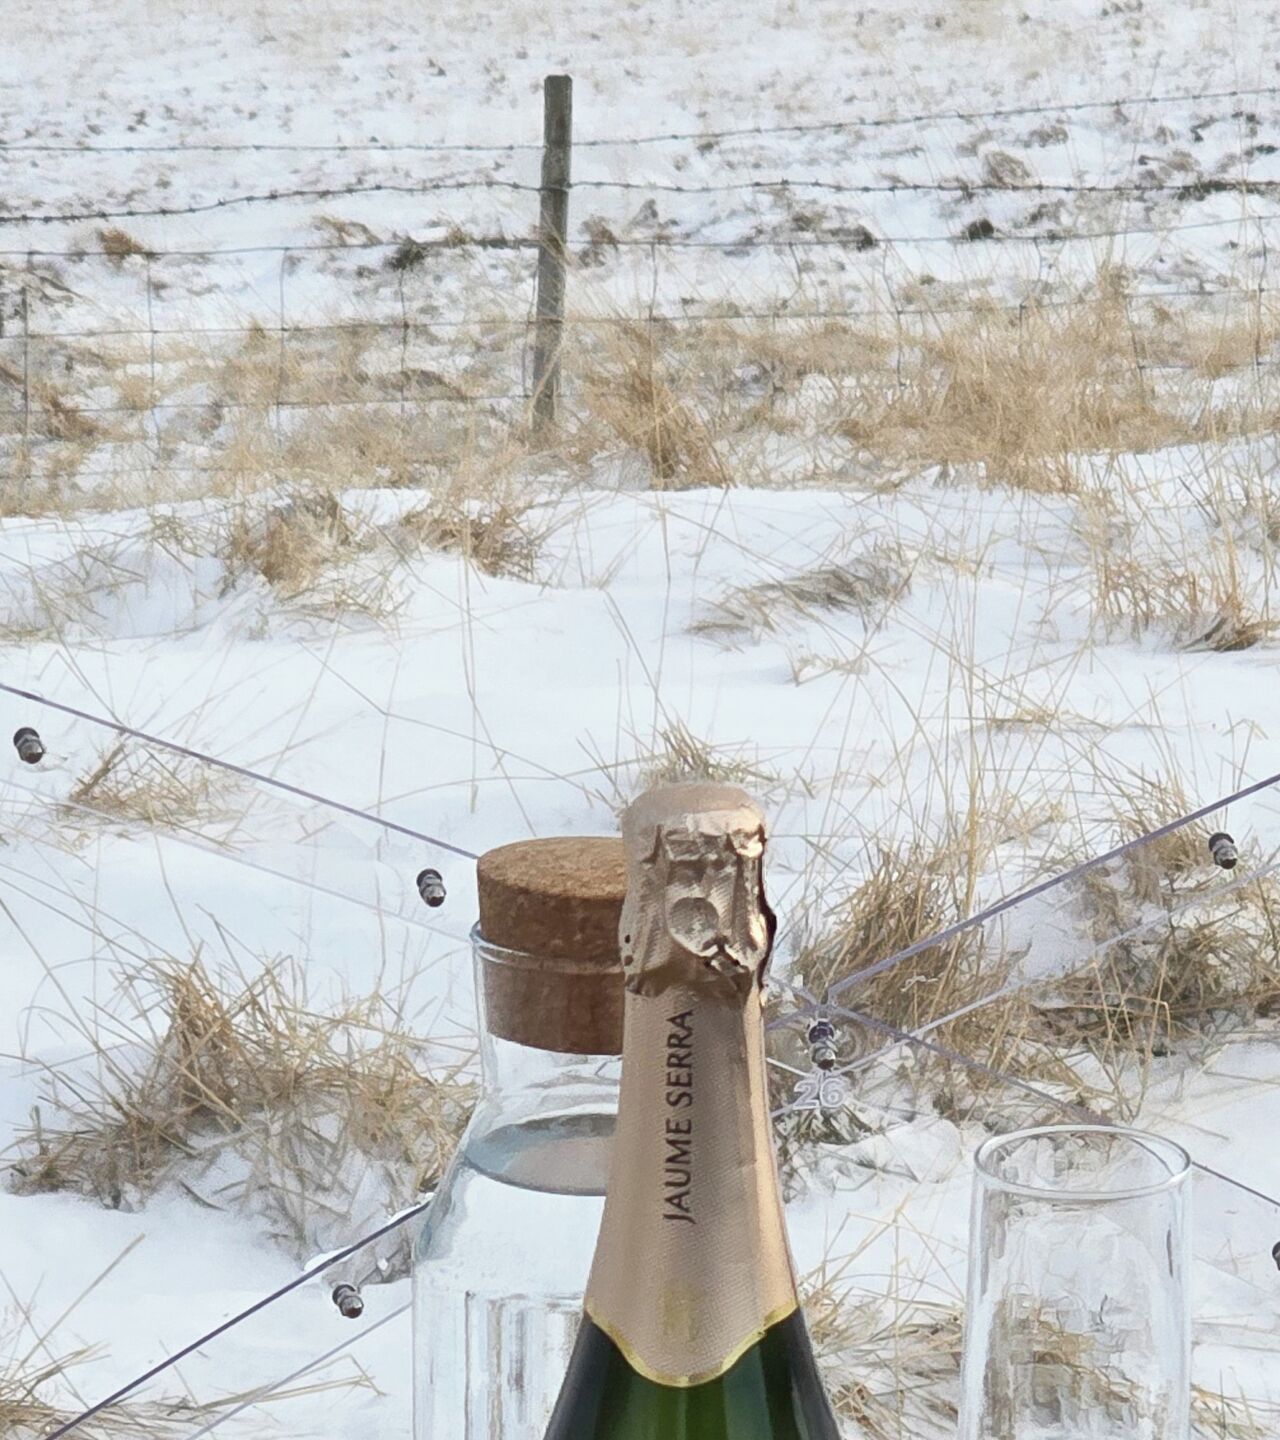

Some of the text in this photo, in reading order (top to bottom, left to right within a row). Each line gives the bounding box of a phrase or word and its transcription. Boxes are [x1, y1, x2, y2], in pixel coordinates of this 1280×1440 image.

[663, 1010, 696, 1225] JAUME SERRA
[793, 1078, 845, 1110] 26
